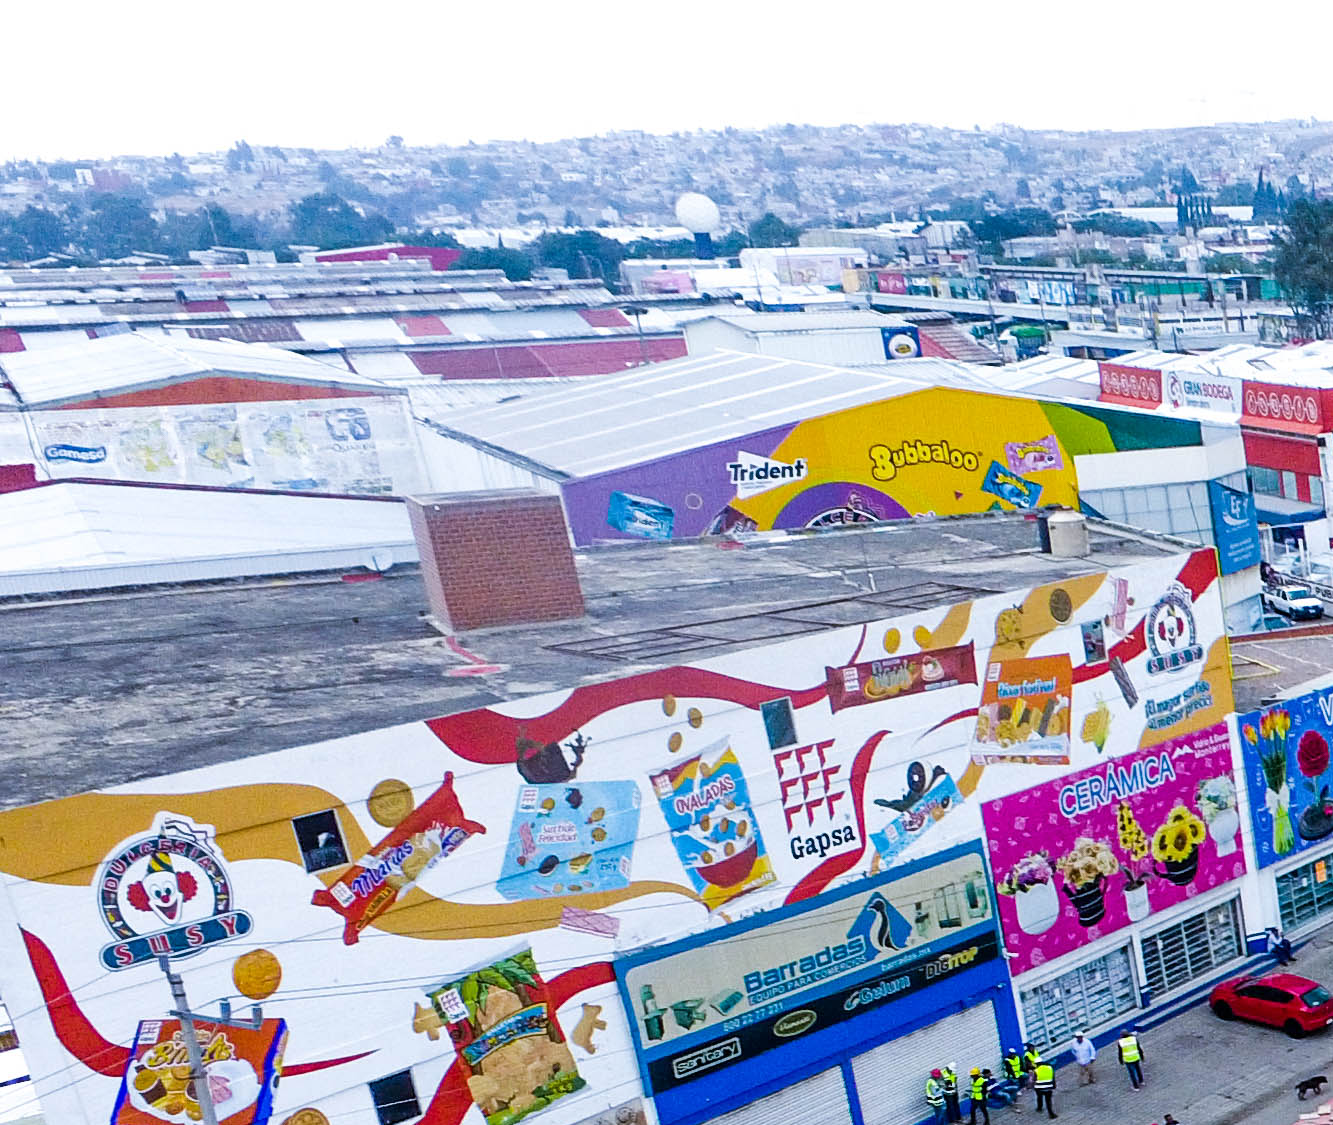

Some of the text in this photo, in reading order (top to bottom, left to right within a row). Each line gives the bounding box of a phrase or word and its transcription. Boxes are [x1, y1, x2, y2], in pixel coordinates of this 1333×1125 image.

[46, 445, 105, 462] Gamesa
[730, 459, 804, 482] Trident
[870, 439, 979, 481] Bubbaloo
[675, 775, 736, 815] OVALADAS
[1060, 752, 1176, 817] CERÁMICA
[790, 824, 856, 860] Gapsa
[104, 839, 212, 892] DULCERIA
[114, 915, 238, 966] SUSY
[743, 934, 866, 994] Barradas
[749, 985, 785, 1005] EQUIPO
[787, 974, 813, 990] PARA
